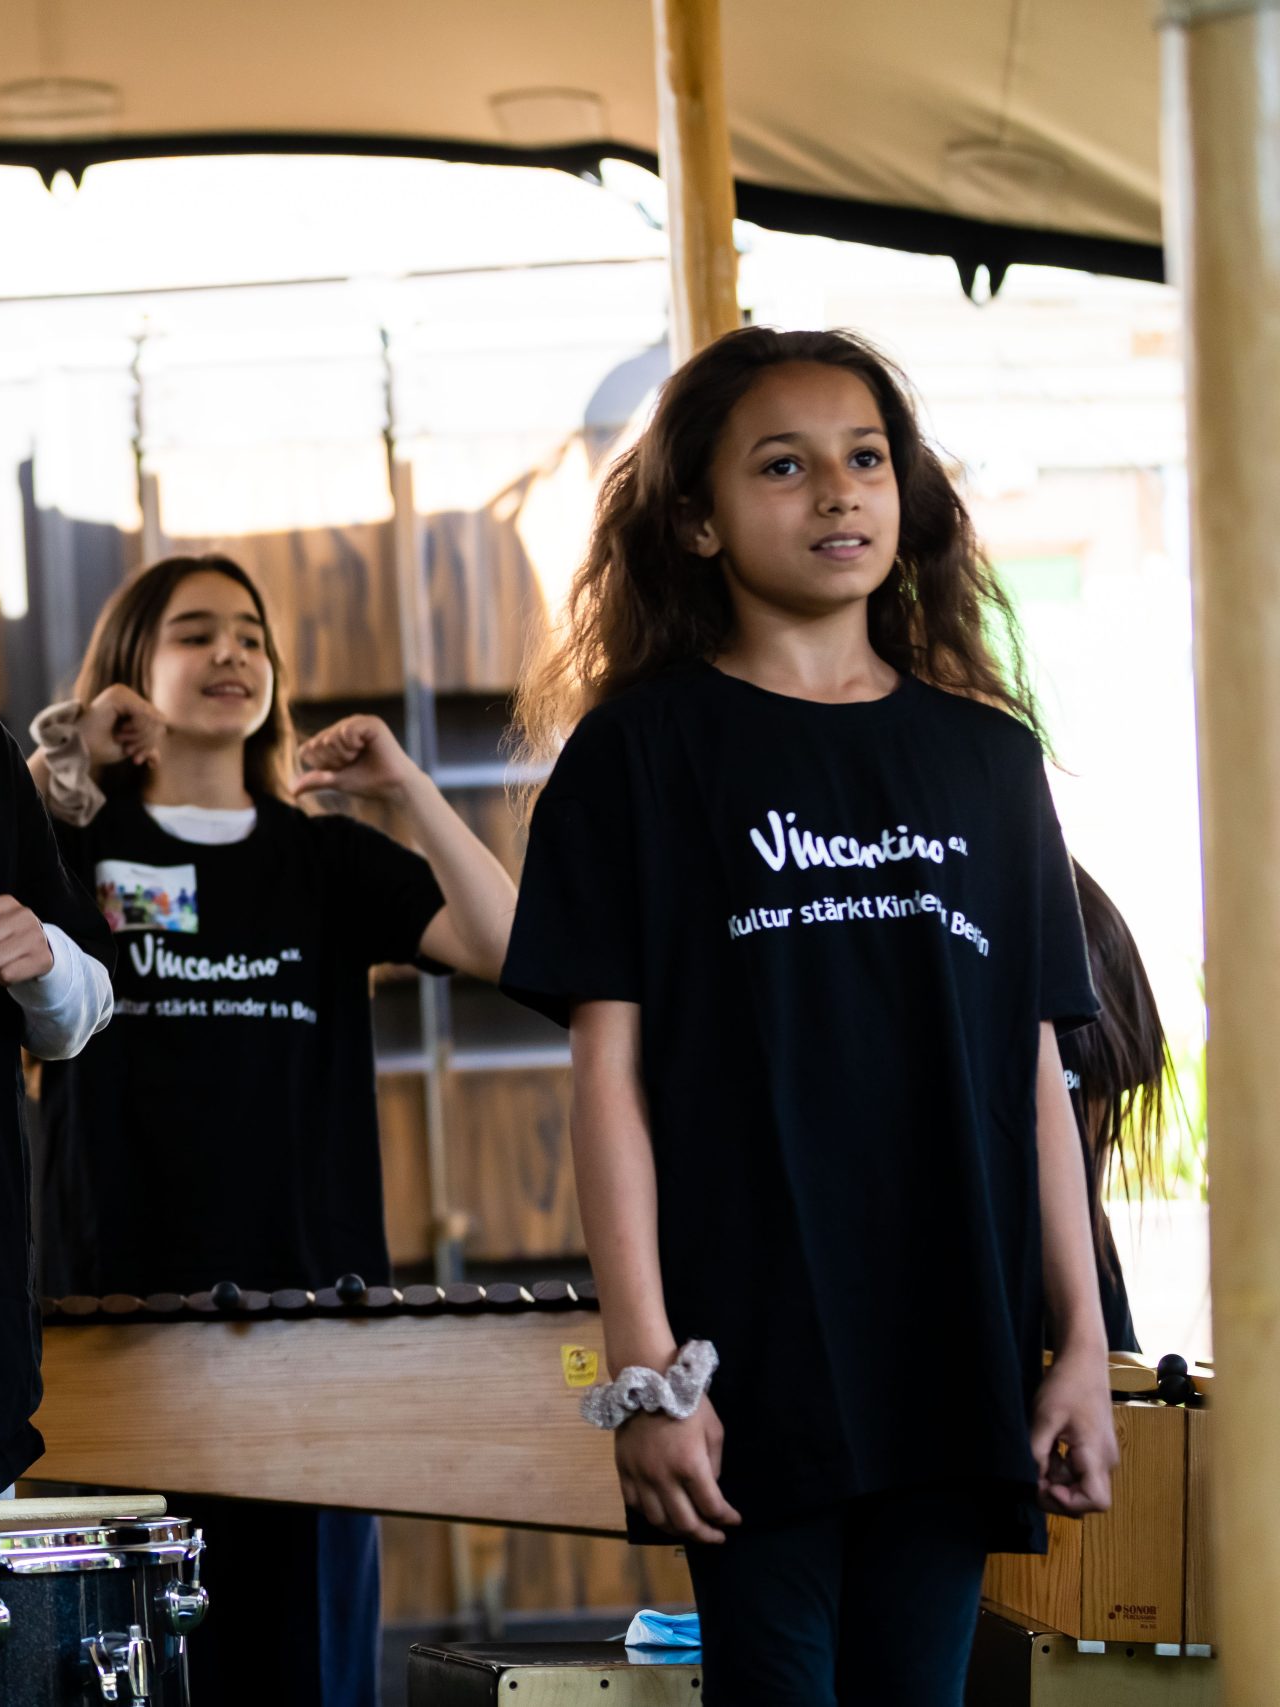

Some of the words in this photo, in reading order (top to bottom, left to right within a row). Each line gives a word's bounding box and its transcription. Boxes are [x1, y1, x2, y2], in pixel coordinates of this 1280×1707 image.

[749, 809, 945, 872] Vincentino
[728, 907, 793, 939] Kultur
[799, 895, 877, 924] stärkt
[130, 933, 280, 982] Vincentino
[154, 998, 208, 1016] stärkt
[212, 997, 267, 1017] Kinder
[1123, 1604, 1157, 1614] SONOR
